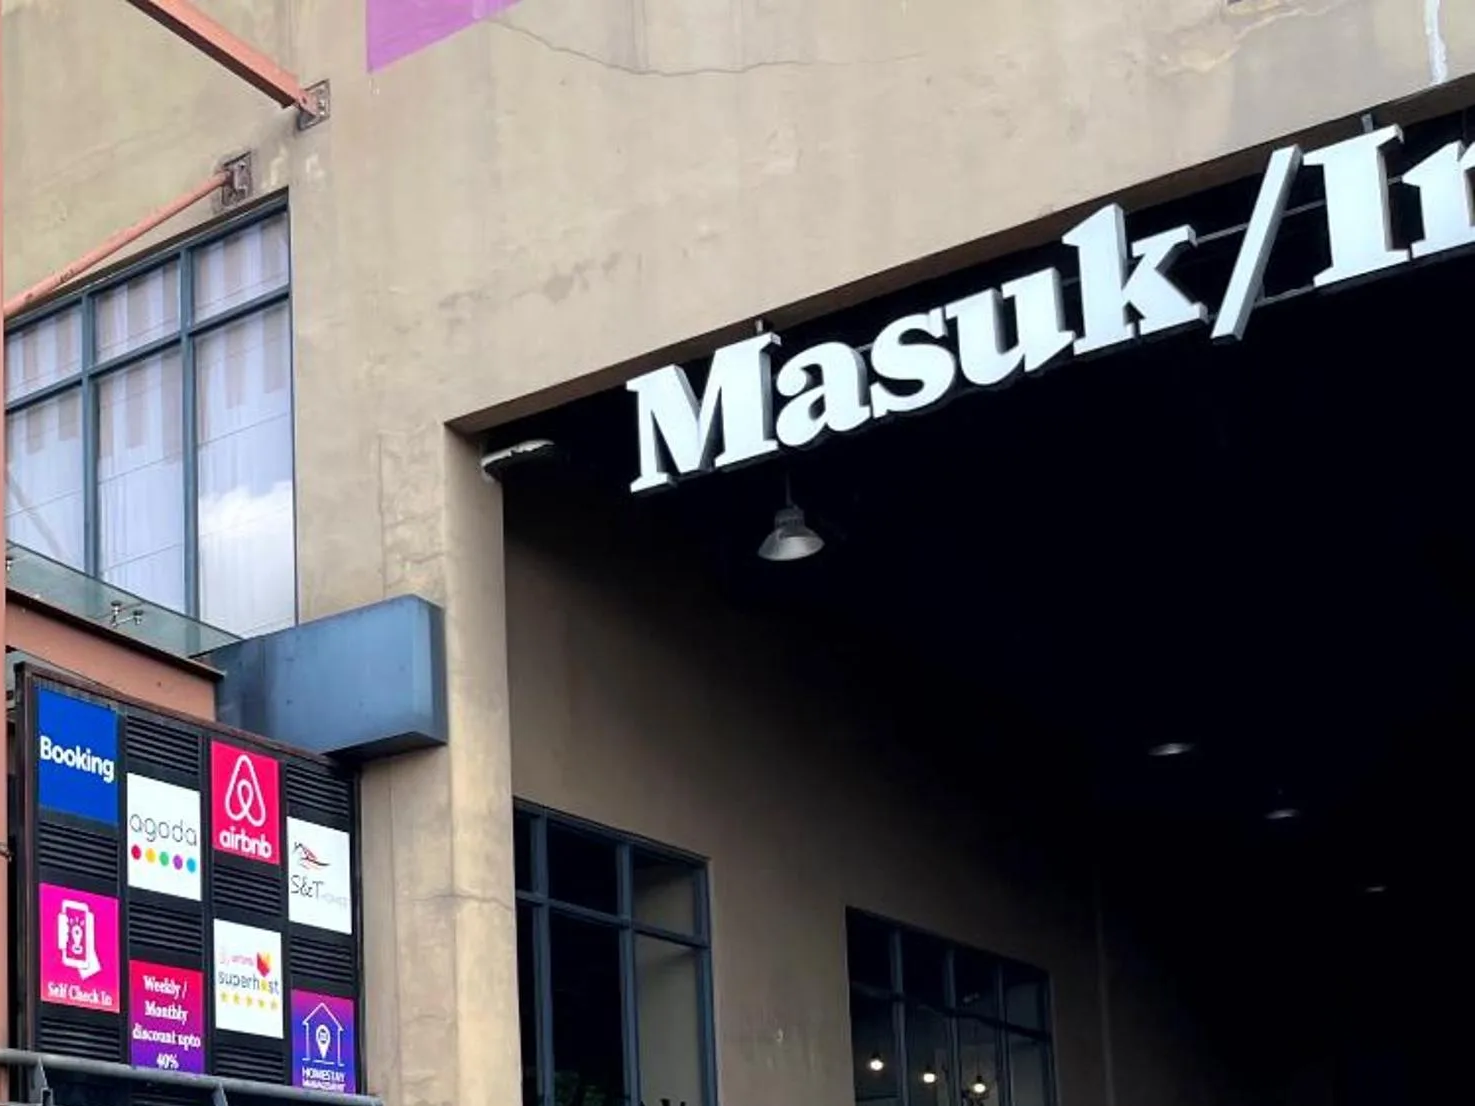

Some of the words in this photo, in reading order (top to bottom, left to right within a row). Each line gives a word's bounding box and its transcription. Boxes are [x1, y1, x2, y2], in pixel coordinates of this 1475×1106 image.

[40, 735, 115, 783] Booking
[129, 813, 197, 847] agoda
[219, 827, 272, 858] airbnb
[48, 982, 68, 998] Self
[69, 984, 99, 1002] Check
[101, 991, 112, 1006] In
[143, 975, 181, 999] Weekly
[144, 1000, 189, 1024] Monthly
[132, 1023, 175, 1045] discount
[156, 1053, 179, 1069] 40%
